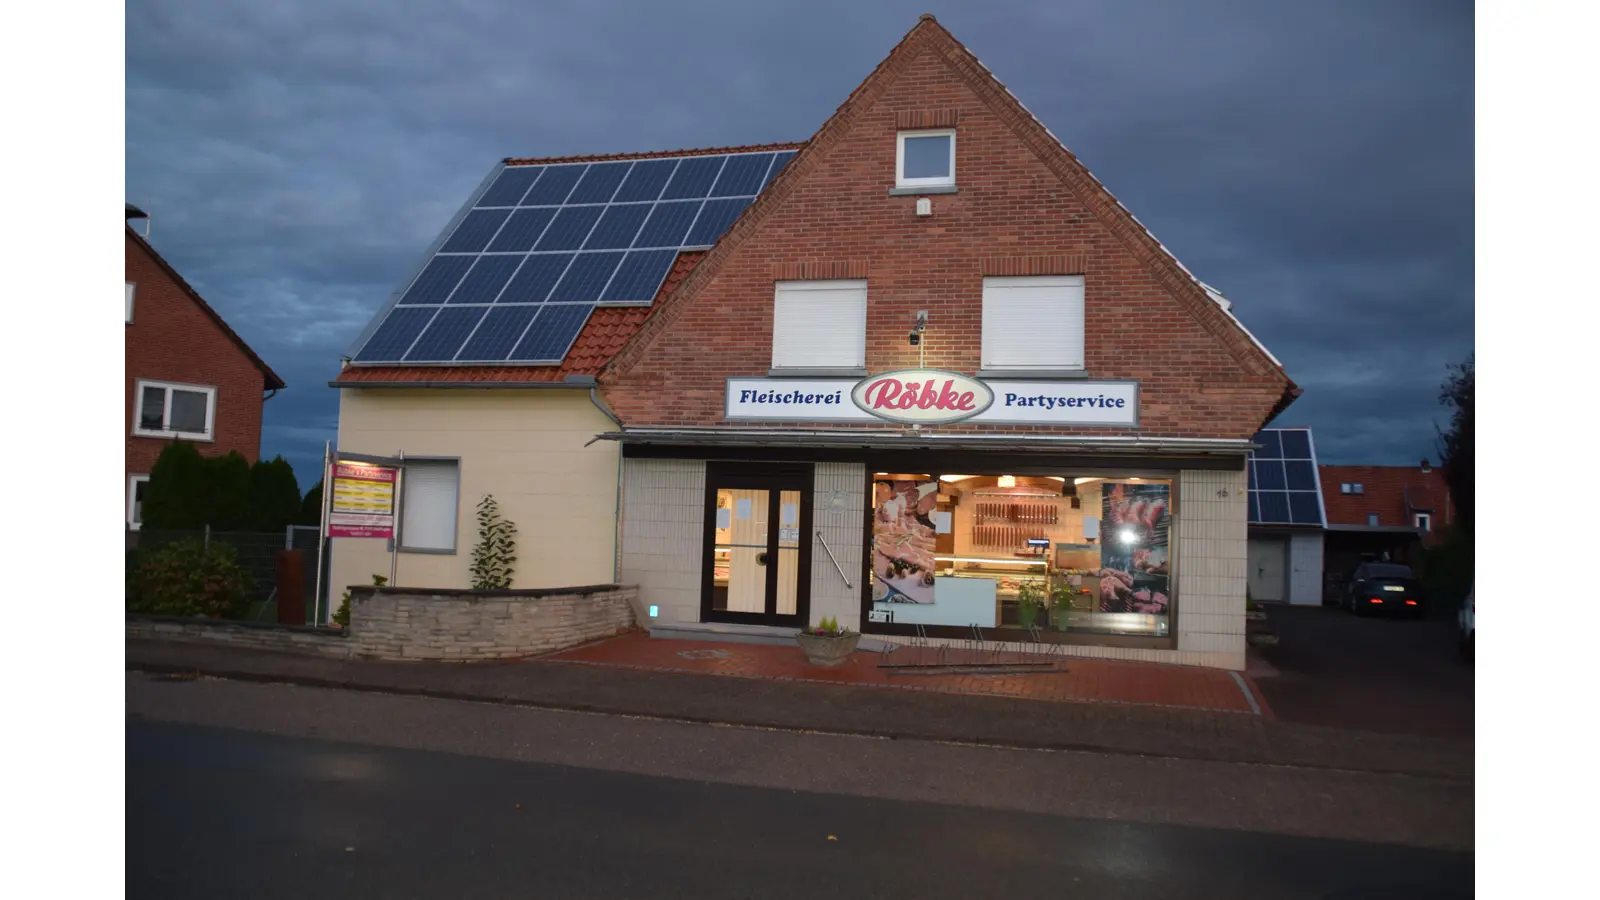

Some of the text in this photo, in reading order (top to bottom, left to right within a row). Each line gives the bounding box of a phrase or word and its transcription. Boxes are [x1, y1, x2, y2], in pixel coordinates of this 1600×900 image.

[739, 378, 1126, 411] Fleischerei Röbke Partyservice
